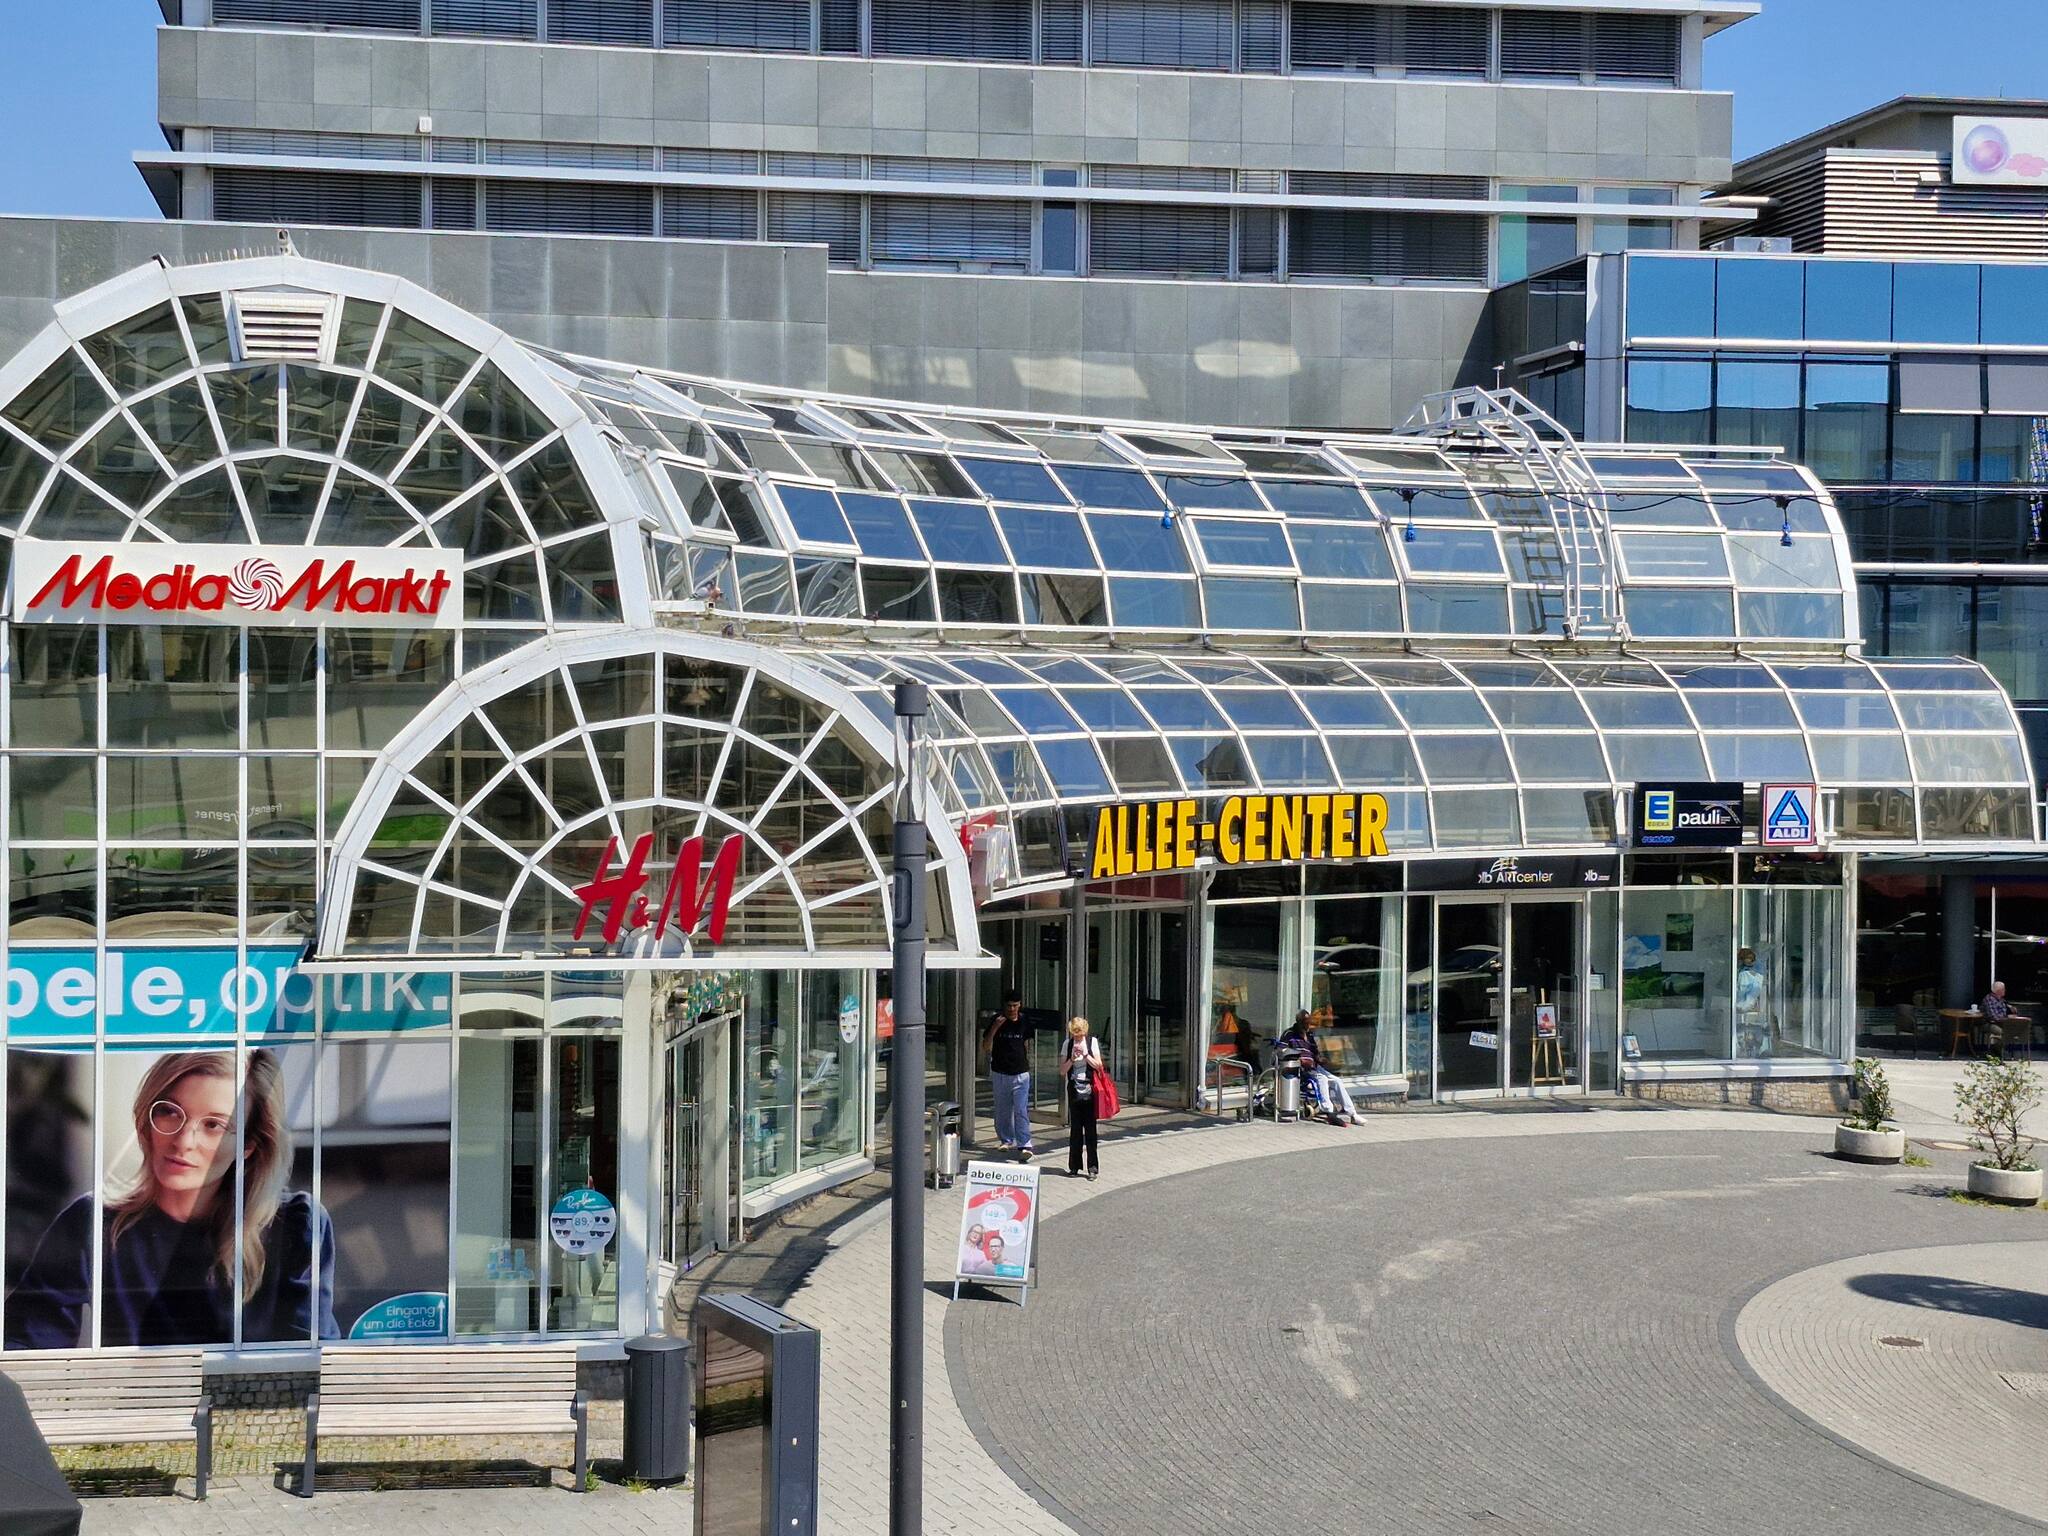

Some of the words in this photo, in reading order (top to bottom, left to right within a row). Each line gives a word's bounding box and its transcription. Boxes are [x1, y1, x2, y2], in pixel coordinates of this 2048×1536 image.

[27, 554, 231, 610] Media
[270, 559, 451, 614] Markt
[1678, 809, 1721, 828] pauli
[1092, 794, 1389, 879] ALLEE-CENTER
[1771, 828, 1806, 839] ALDI
[571, 831, 744, 945] H&M
[386, 1305, 436, 1319] Eingang
[363, 1320, 384, 1330] um
[386, 1318, 406, 1329] die
[407, 1317, 436, 1328] Ecke
